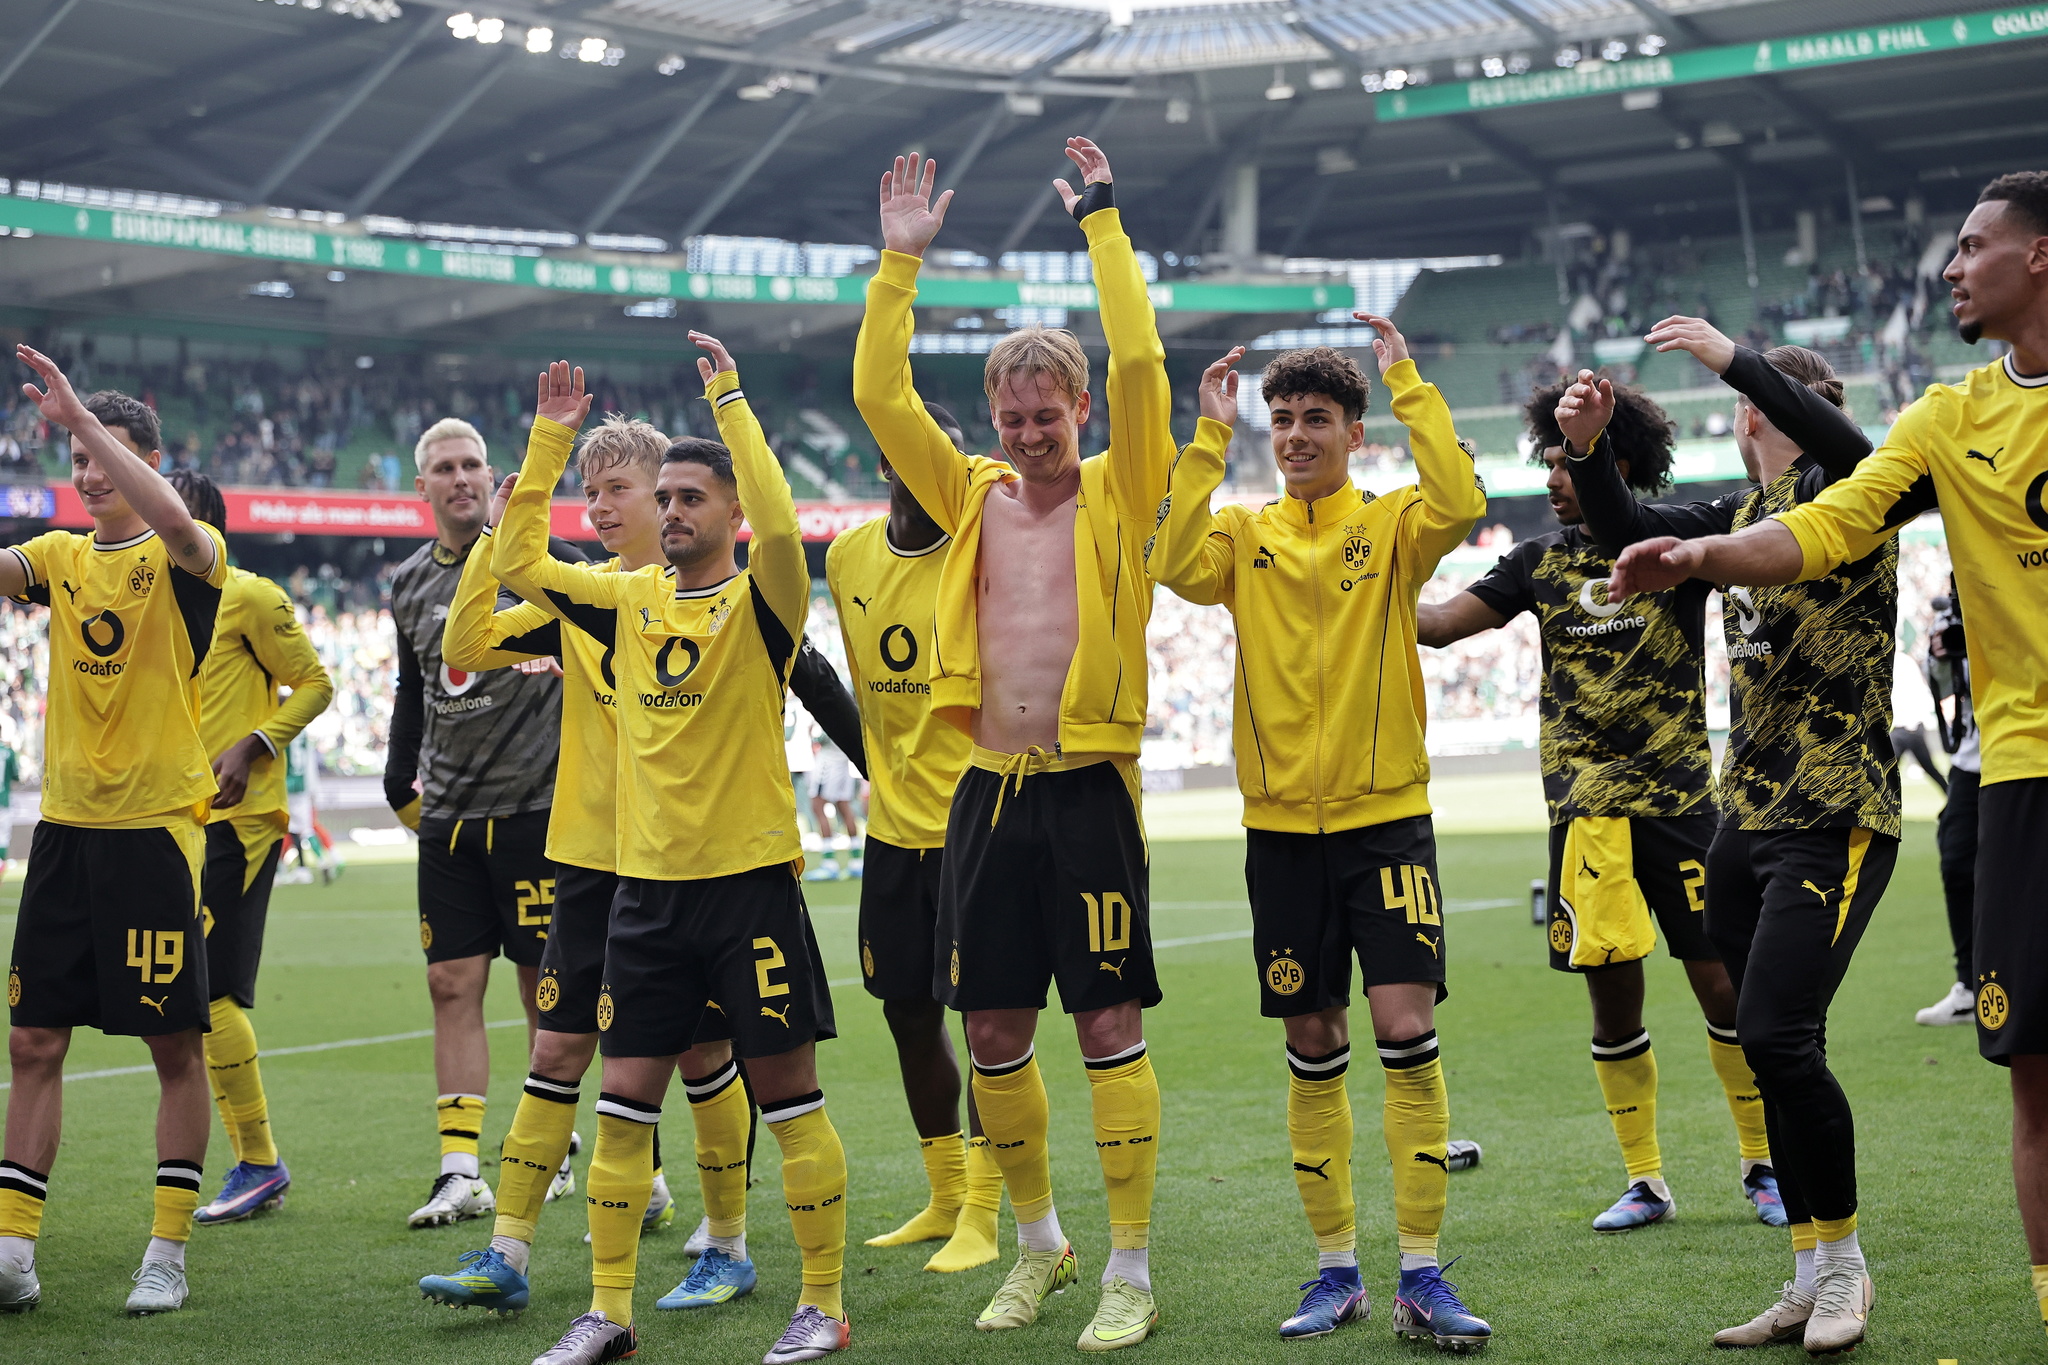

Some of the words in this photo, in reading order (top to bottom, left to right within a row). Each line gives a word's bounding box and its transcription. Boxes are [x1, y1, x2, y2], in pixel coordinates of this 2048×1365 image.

[1786, 31, 1874, 64] HARALD
[1876, 25, 1930, 52] PIHL
[441, 248, 515, 281] MEISTER
[1345, 539, 1370, 562] BVB
[1253, 558, 1268, 569] KING
[1354, 559, 1364, 568] 09
[1565, 615, 1646, 637] vodafone
[1727, 638, 1772, 659] odafone
[868, 680, 930, 695] vodafone
[638, 690, 707, 708] vodafon
[514, 878, 556, 926] 25
[1379, 864, 1440, 927] 40
[1080, 891, 1131, 953] 10
[1553, 924, 1571, 943] BVB
[126, 928, 184, 984] 49
[752, 936, 790, 999] 2
[1272, 962, 1300, 986] BVB
[539, 980, 557, 1002] BVB
[1282, 983, 1293, 992] 09
[599, 998, 611, 1020] BVB
[1981, 988, 2005, 1018] BVB
[1989, 1014, 1999, 1025] 09
[523, 1161, 548, 1171] 09
[602, 1201, 628, 1209] 09
